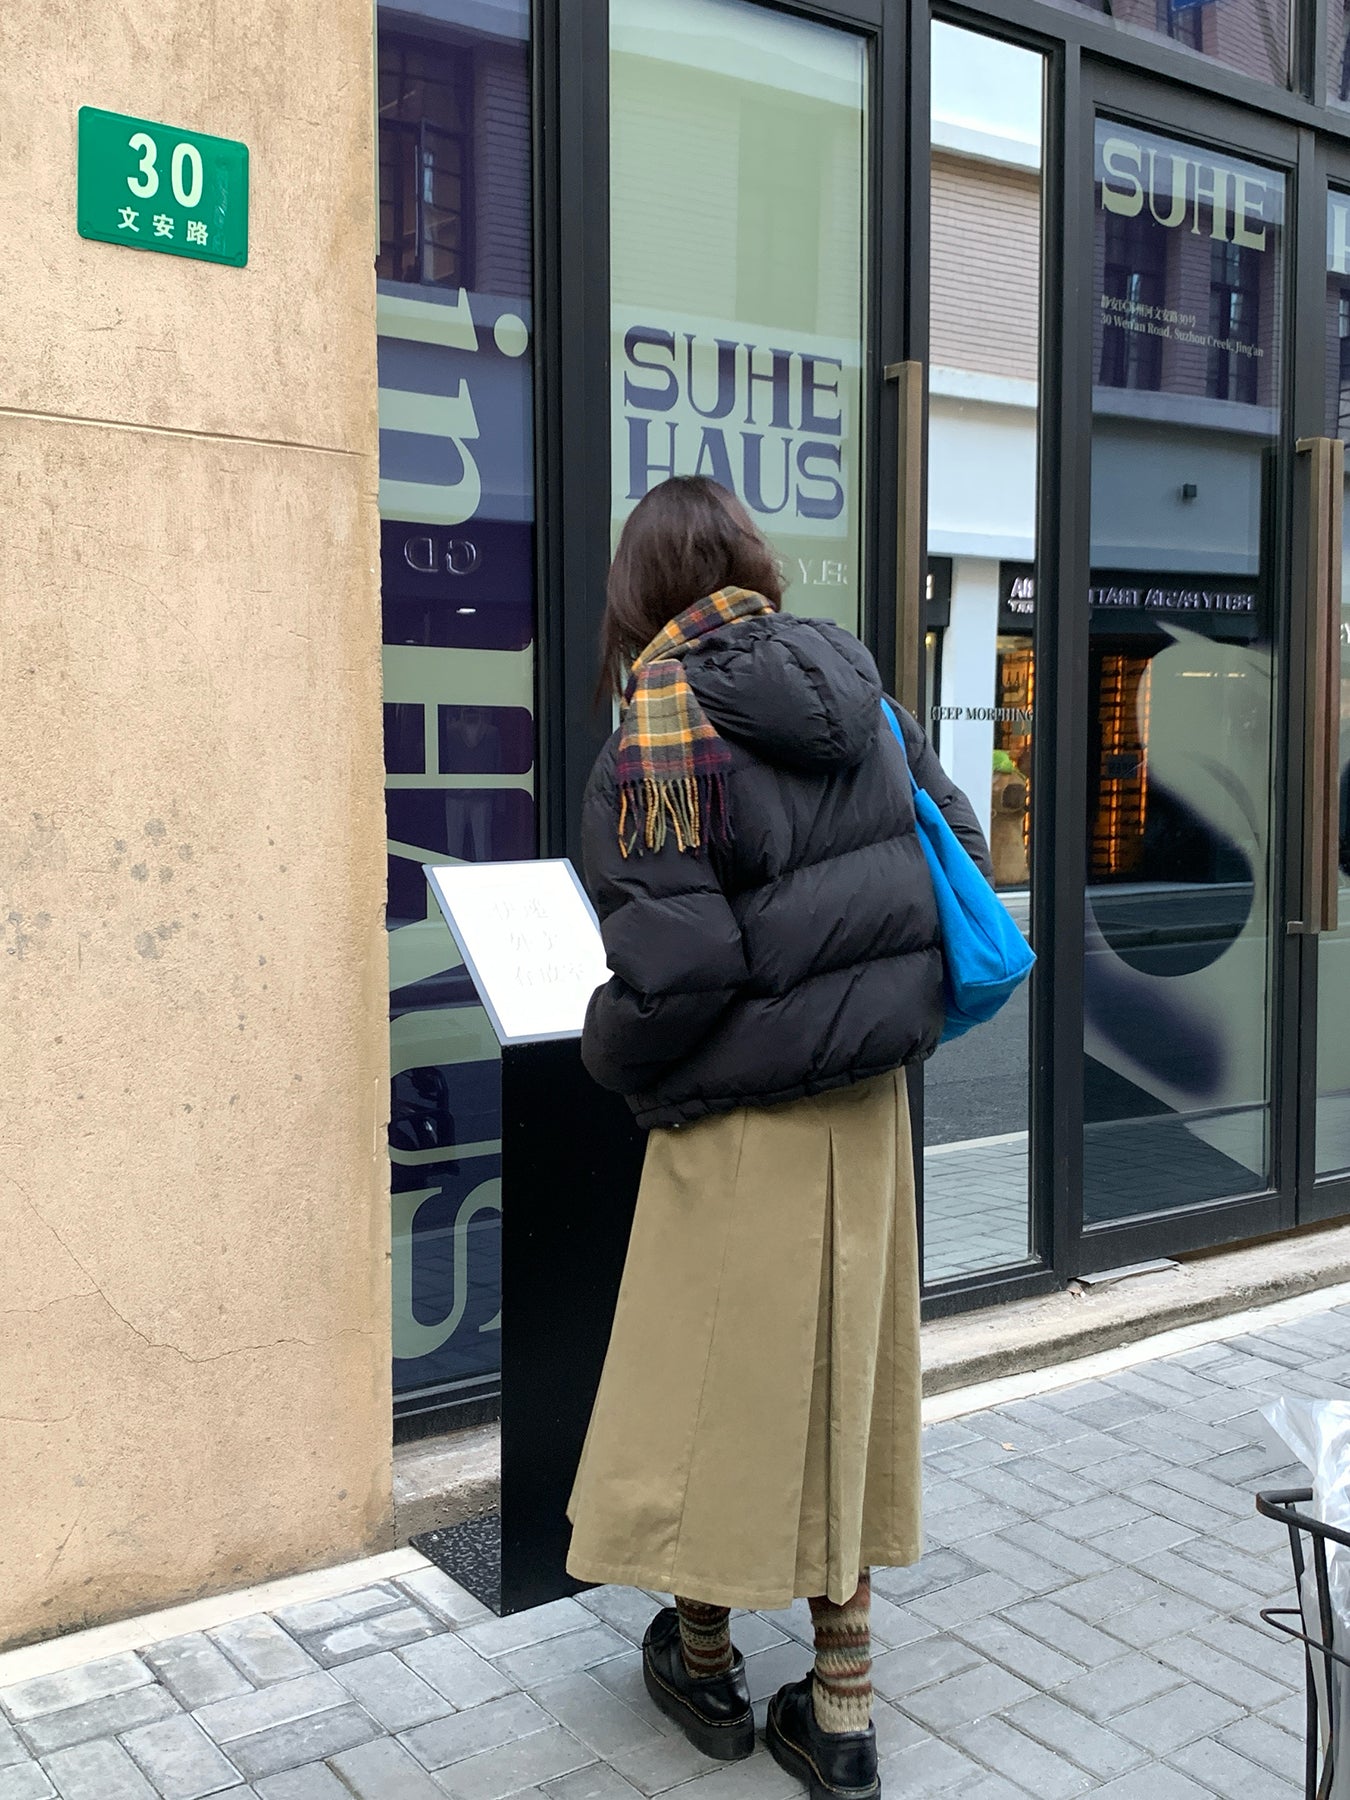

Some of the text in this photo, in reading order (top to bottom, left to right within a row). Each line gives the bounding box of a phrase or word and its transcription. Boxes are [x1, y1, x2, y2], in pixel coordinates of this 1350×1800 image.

[127, 133, 203, 208] 30
[1102, 138, 1266, 251] SUHE
[117, 206, 209, 246] 文安路
[1101, 313, 1112, 326] 30
[1174, 329, 1205, 346] Suzhou
[624, 325, 843, 436] SUHE
[625, 415, 844, 520] HAUS
[929, 706, 1034, 722] KEEP MORPHING
